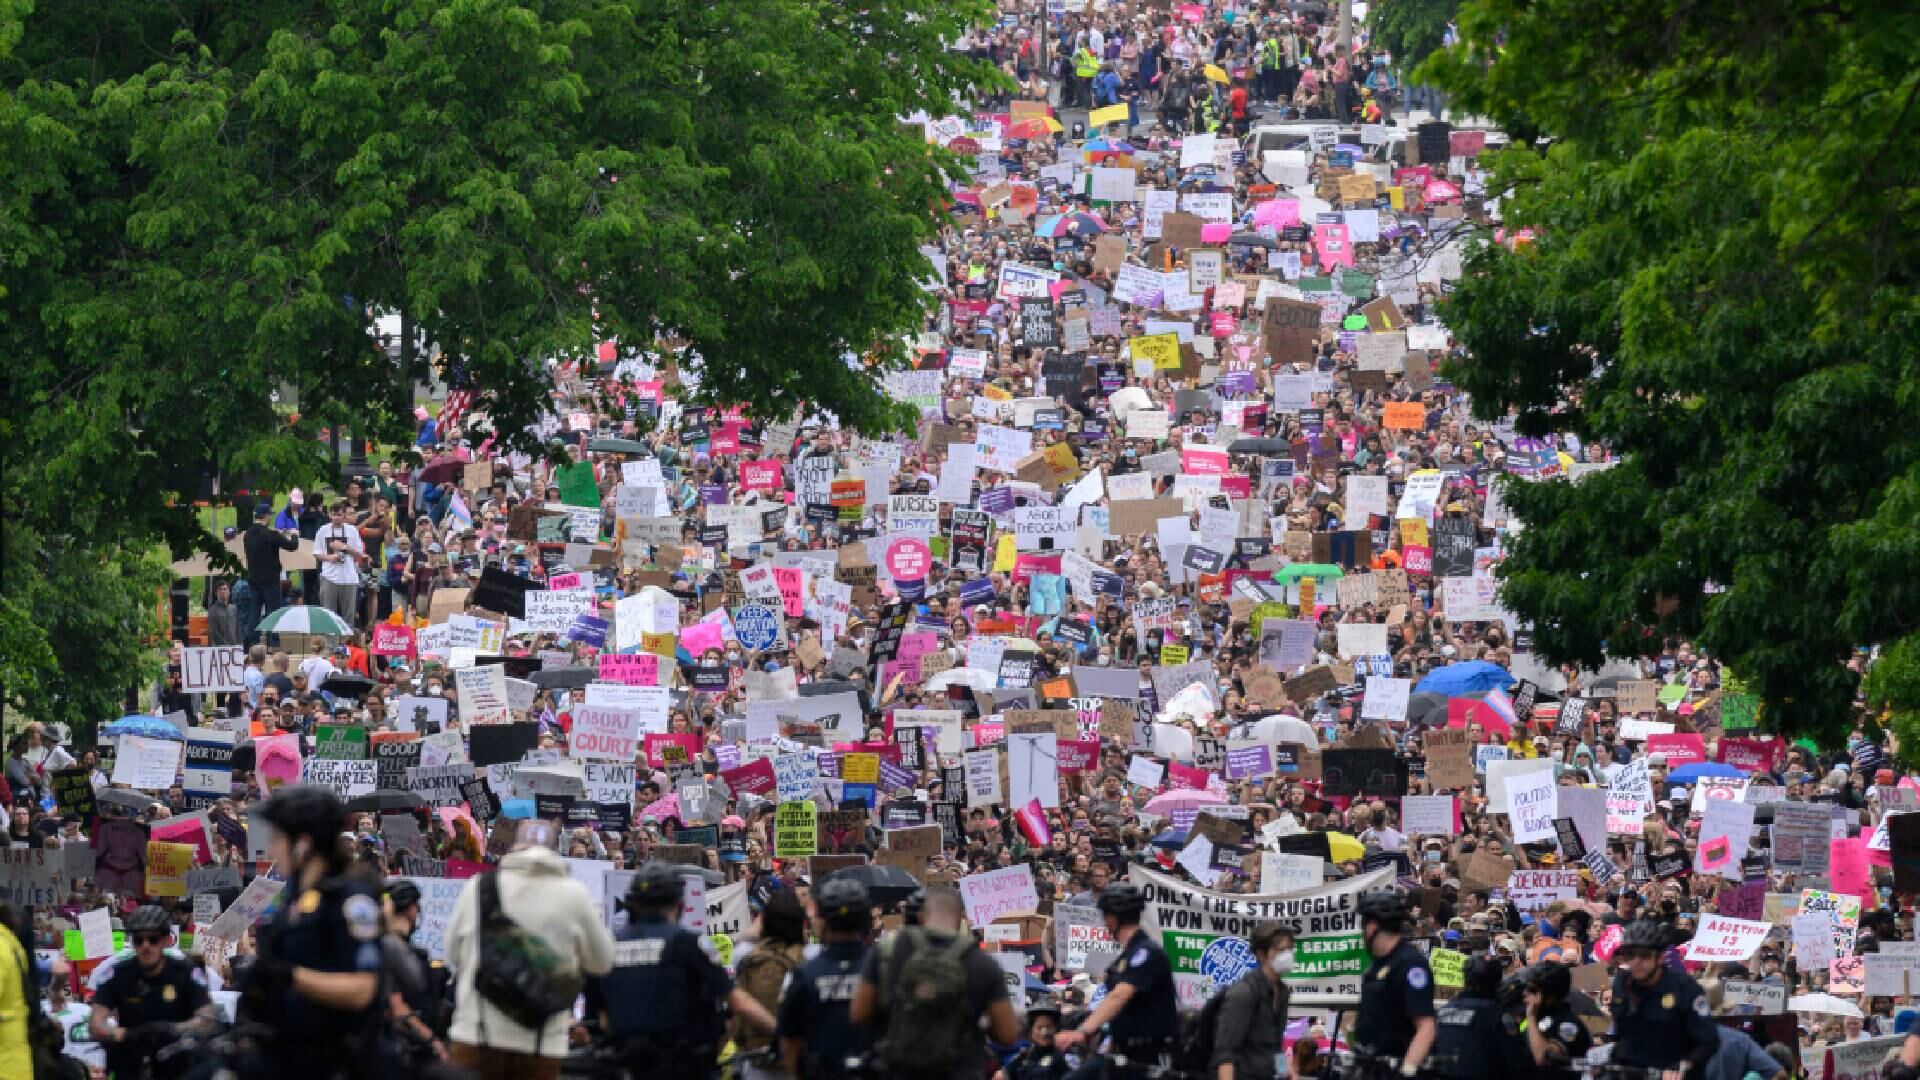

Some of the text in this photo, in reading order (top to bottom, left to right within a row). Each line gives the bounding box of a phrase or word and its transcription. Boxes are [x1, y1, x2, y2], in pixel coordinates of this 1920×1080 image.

[183, 647, 245, 688] LIARS
[1068, 698, 1102, 710] STOP
[577, 710, 634, 730] ABORT
[186, 746, 233, 760] ABORTION
[379, 742, 419, 755] GOOD
[575, 733, 634, 758] COURT
[311, 760, 377, 770] KEEP YOUR
[200, 773, 214, 787] IS
[309, 771, 377, 784] ROSARIES
[599, 788, 633, 803] BACK
[4, 848, 44, 866] BANS
[1144, 884, 1349, 918] ONLY THE STRUGGLE
[1158, 907, 1357, 937] WON WOM'S RIGH
[1707, 920, 1766, 935] ABORTION
[1071, 926, 1089, 940] NO
[1722, 935, 1739, 947] IS
[1292, 958, 1361, 974] CIALISM!
